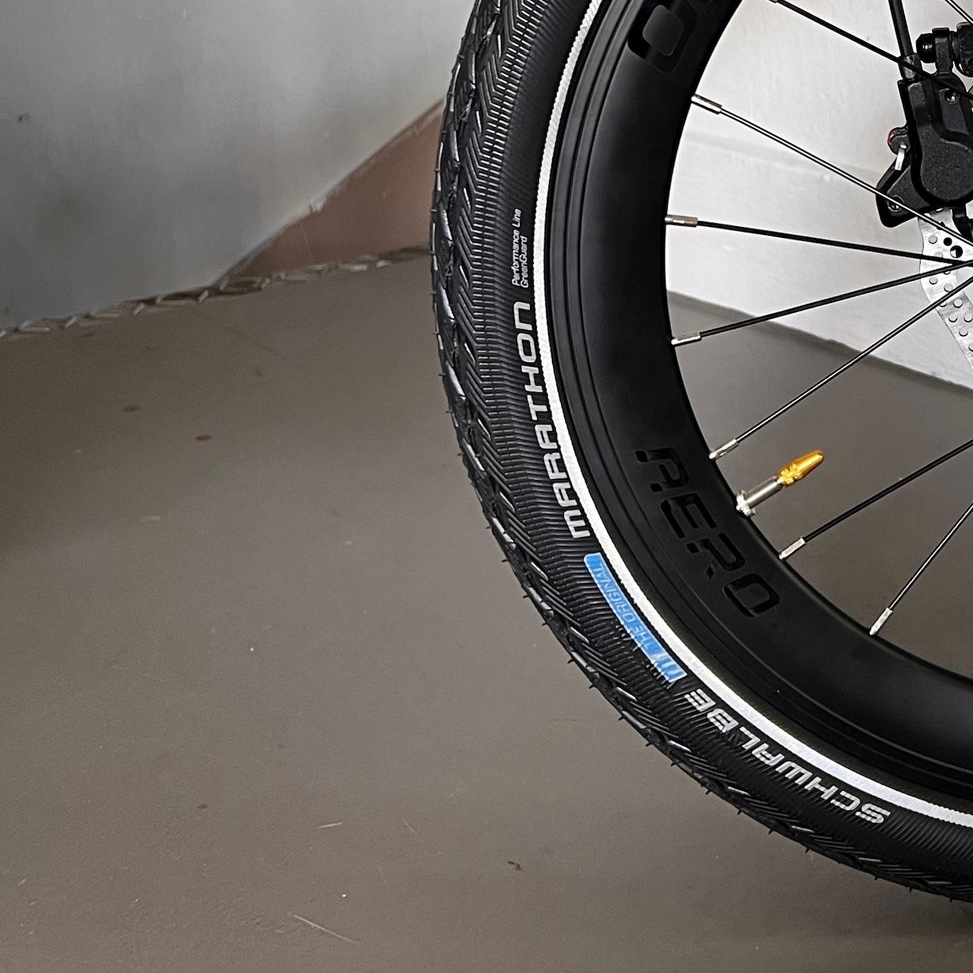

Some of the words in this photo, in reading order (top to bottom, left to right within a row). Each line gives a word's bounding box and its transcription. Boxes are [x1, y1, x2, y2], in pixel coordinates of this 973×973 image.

[512, 208, 521, 228] Line
[511, 229, 521, 287] Performance
[519, 235, 529, 288] GreenGuard
[513, 300, 591, 539] MARATHON
[635, 447, 781, 618] AERO
[593, 562, 636, 623] ORIGINAL
[633, 626, 652, 649] THE
[684, 687, 891, 824] SCHWALBE
